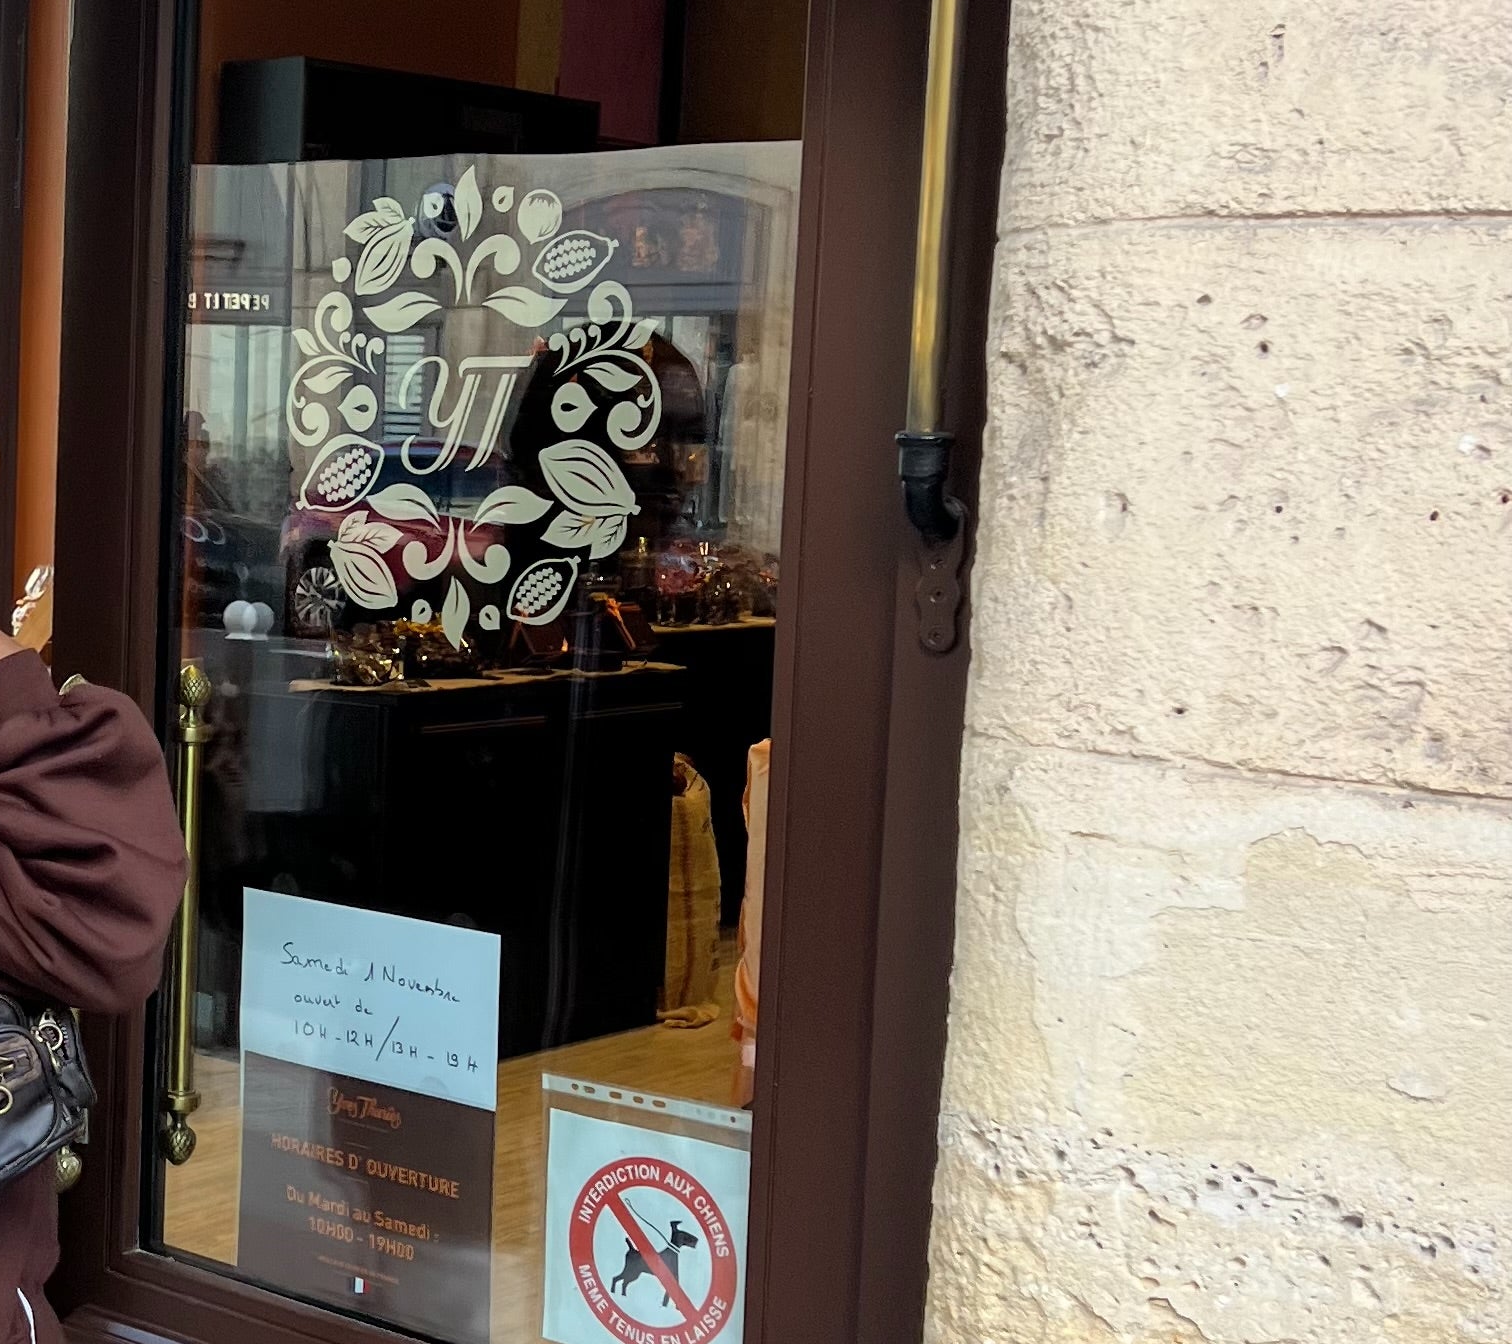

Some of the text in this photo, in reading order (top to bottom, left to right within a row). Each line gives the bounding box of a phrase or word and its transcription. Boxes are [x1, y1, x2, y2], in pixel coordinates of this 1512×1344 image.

[280, 941, 461, 1003] Samedi 1 Novembre
[355, 999, 374, 1016] de
[271, 1133, 345, 1168] HORAIRES
[366, 1158, 461, 1200] OUVERTURE
[286, 1184, 305, 1204] Du
[308, 1190, 350, 1218] Mardi
[352, 1207, 372, 1224] au
[373, 1210, 431, 1241] Samedi
[308, 1216, 354, 1244] 10H00
[368, 1233, 415, 1261] 19H00
[578, 1164, 730, 1258] INTERDICTION AUX CHIENS
[578, 1264, 609, 1314] MEME
